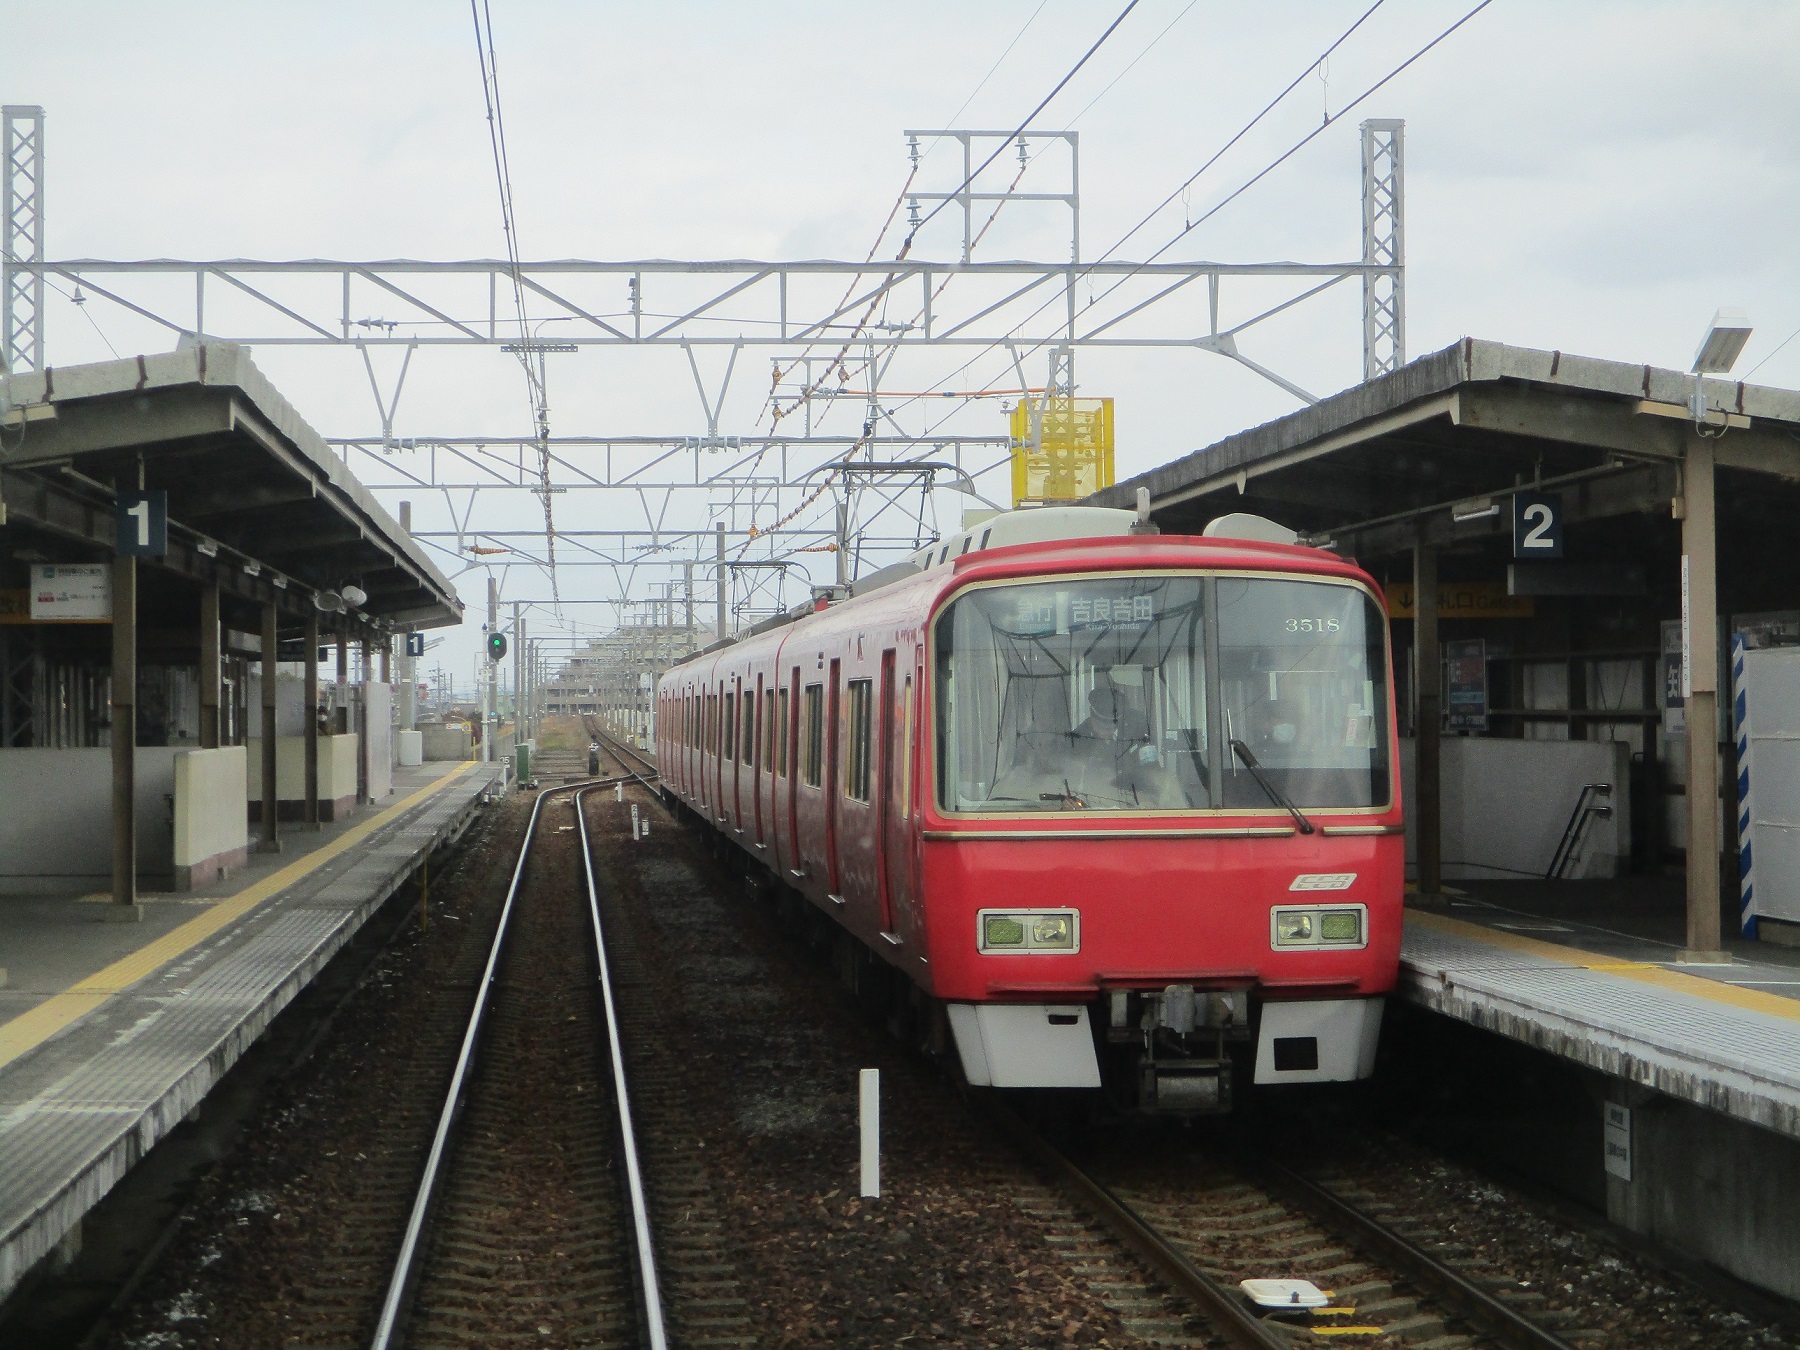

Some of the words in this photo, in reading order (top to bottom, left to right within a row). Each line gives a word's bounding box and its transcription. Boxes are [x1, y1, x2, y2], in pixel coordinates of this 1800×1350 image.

[127, 500, 149, 546] 1
[1523, 503, 1554, 548] 2
[1071, 595, 1153, 623] 吉良吉田
[1284, 617, 1341, 633] 3518
[409, 636, 419, 653] 1
